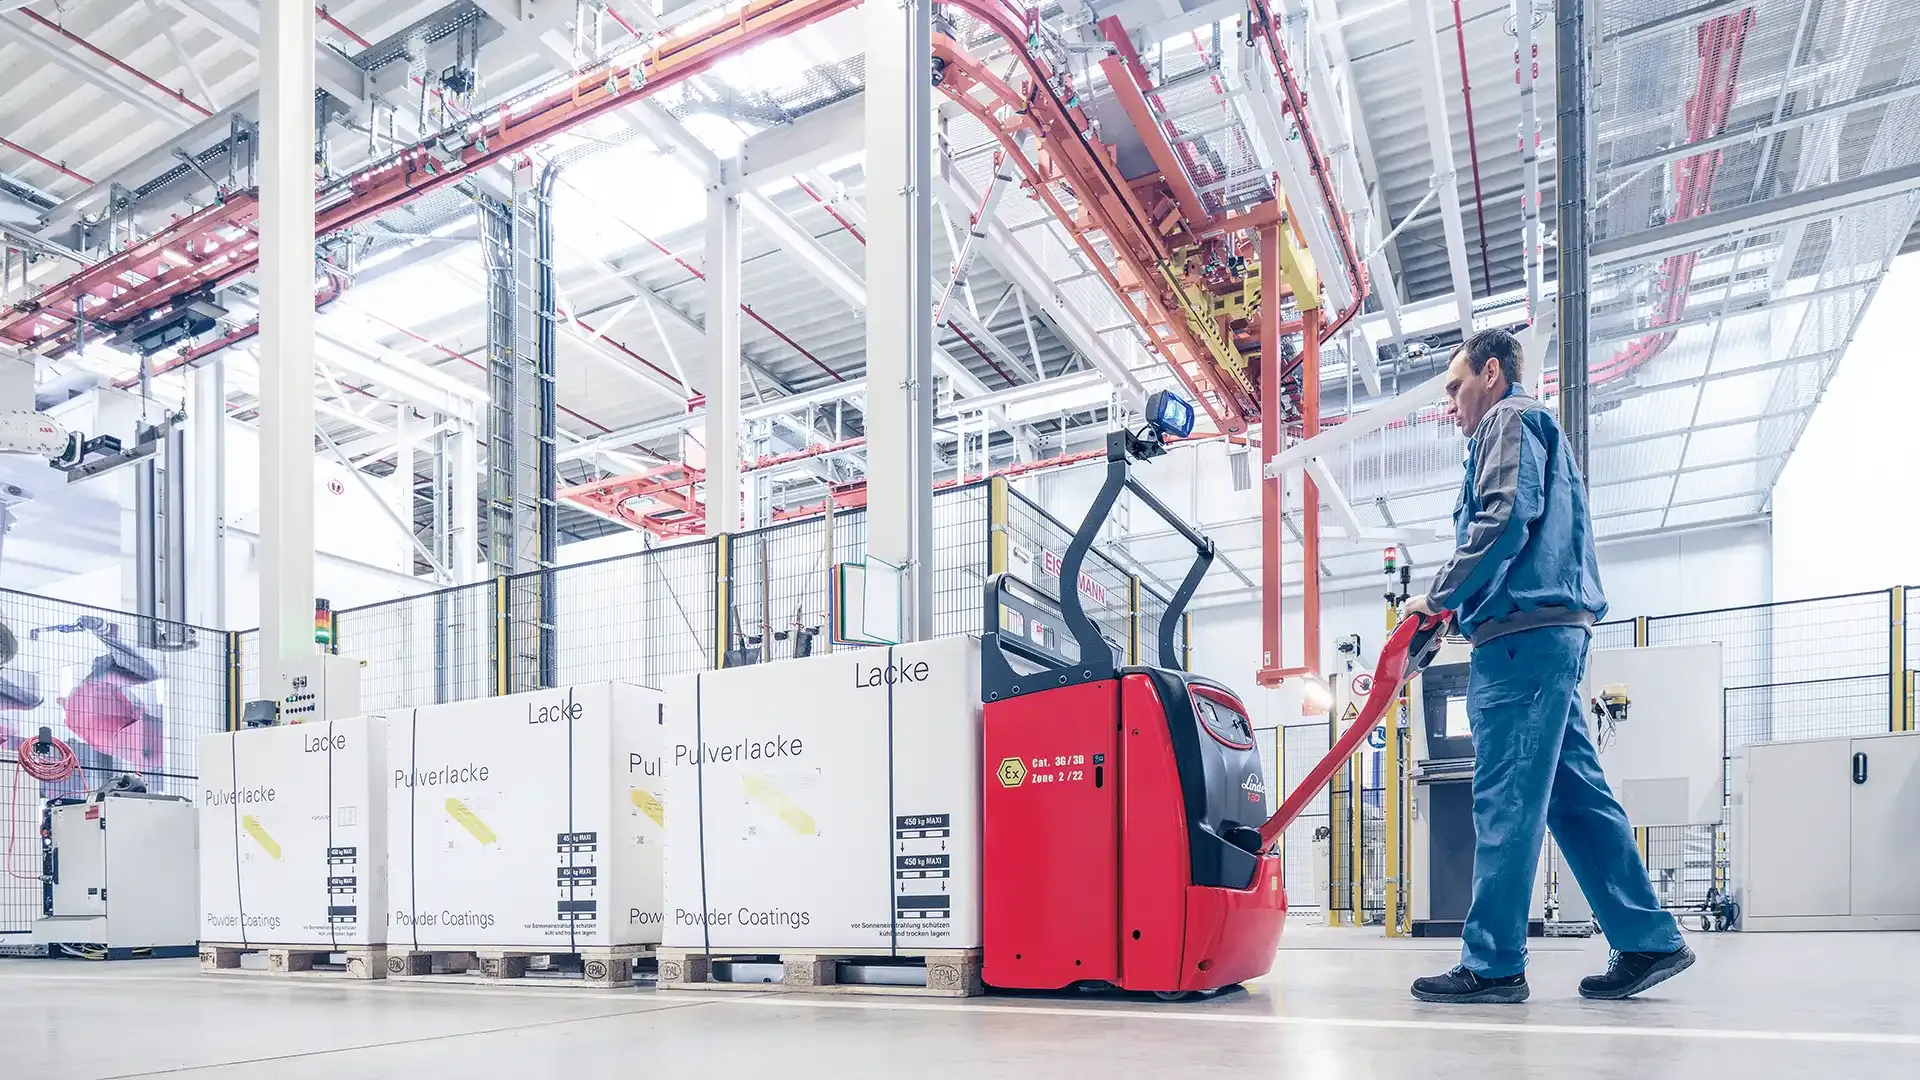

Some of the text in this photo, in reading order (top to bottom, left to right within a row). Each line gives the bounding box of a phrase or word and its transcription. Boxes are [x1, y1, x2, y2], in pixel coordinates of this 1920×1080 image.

[1045, 552, 1105, 604] EISMANN
[855, 657, 929, 688] Lacke
[528, 699, 582, 724] Lacke
[304, 734, 346, 752] Lacke
[675, 735, 803, 766] Pulverlacke
[1032, 758, 1050, 768] Cat.
[395, 763, 489, 788] Pulverlacke
[1032, 774, 1053, 783] Zone
[1241, 773, 1266, 794] Linde
[206, 785, 276, 806] Pulverlacke
[904, 818, 916, 826] 450
[918, 818, 925, 826] kg
[904, 857, 942, 866] 450 kg MAXI
[208, 912, 280, 930] Powder Coatings
[396, 910, 494, 929] Powder Coatings
[630, 908, 664, 924] Pow
[676, 908, 810, 930] Powder Coatings
[930, 930, 950, 938] lagern
